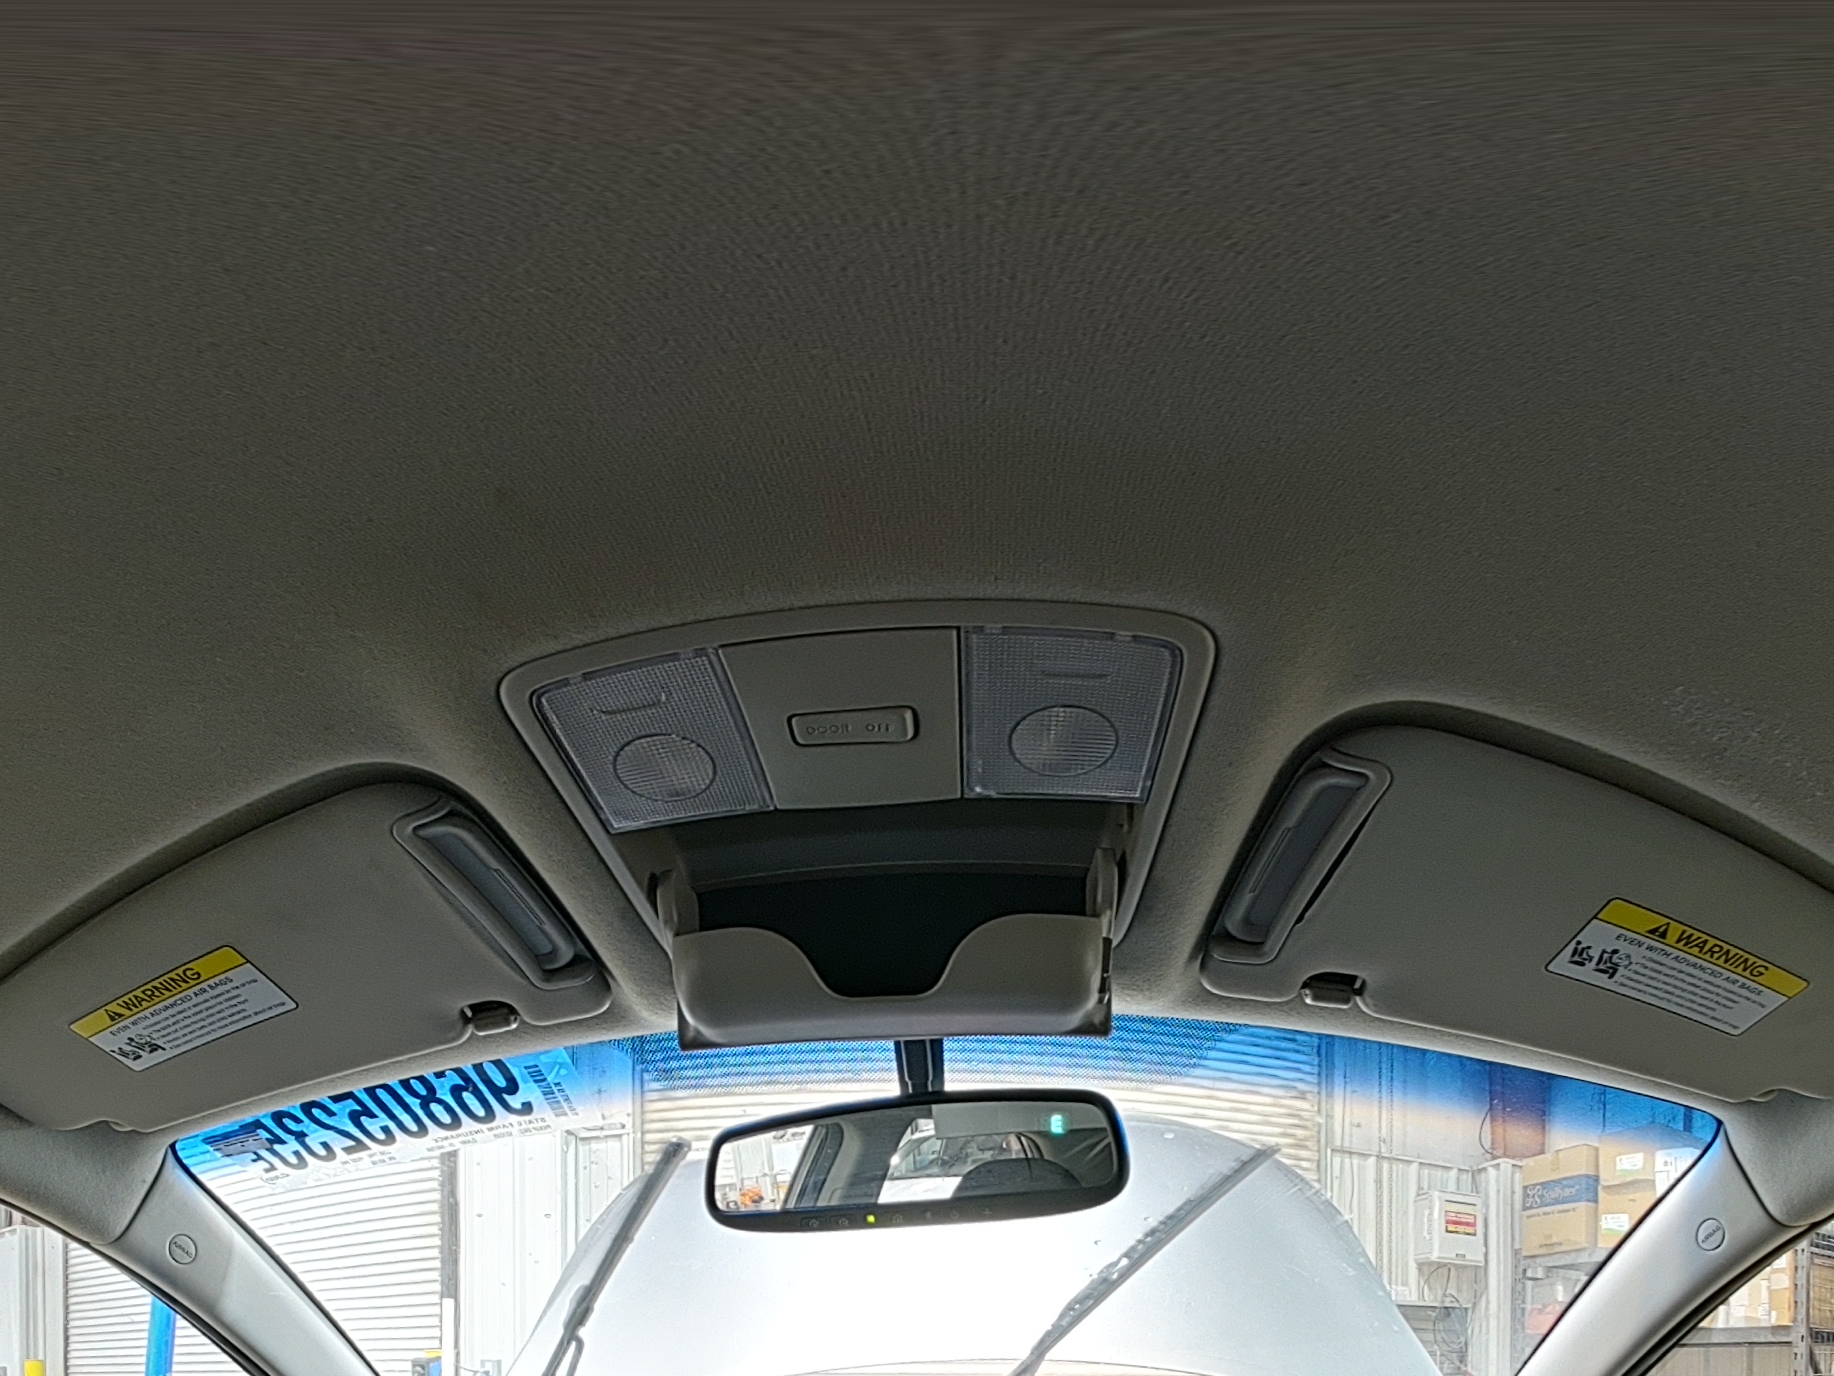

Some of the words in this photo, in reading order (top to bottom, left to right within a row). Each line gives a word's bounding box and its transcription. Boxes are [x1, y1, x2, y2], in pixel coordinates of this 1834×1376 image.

[865, 722, 892, 733] OFF
[1615, 933, 1645, 949] EVEN
[1645, 942, 1672, 959] WITH
[1671, 953, 1723, 981] ADVANCED
[1722, 974, 1740, 988] AIR
[1738, 979, 1765, 997] BAGS
[1674, 929, 1769, 978] WARNING
[109, 1021, 131, 1037] EVEN
[130, 1014, 151, 1028] WITH
[150, 993, 194, 1019] ADVANCED
[193, 986, 208, 1001] AIR
[207, 976, 235, 994] BAGS
[117, 967, 202, 1013] WARNING
[173, 1240, 194, 1259] AIRBAG
[1701, 1224, 1721, 1244] AIRBAG
